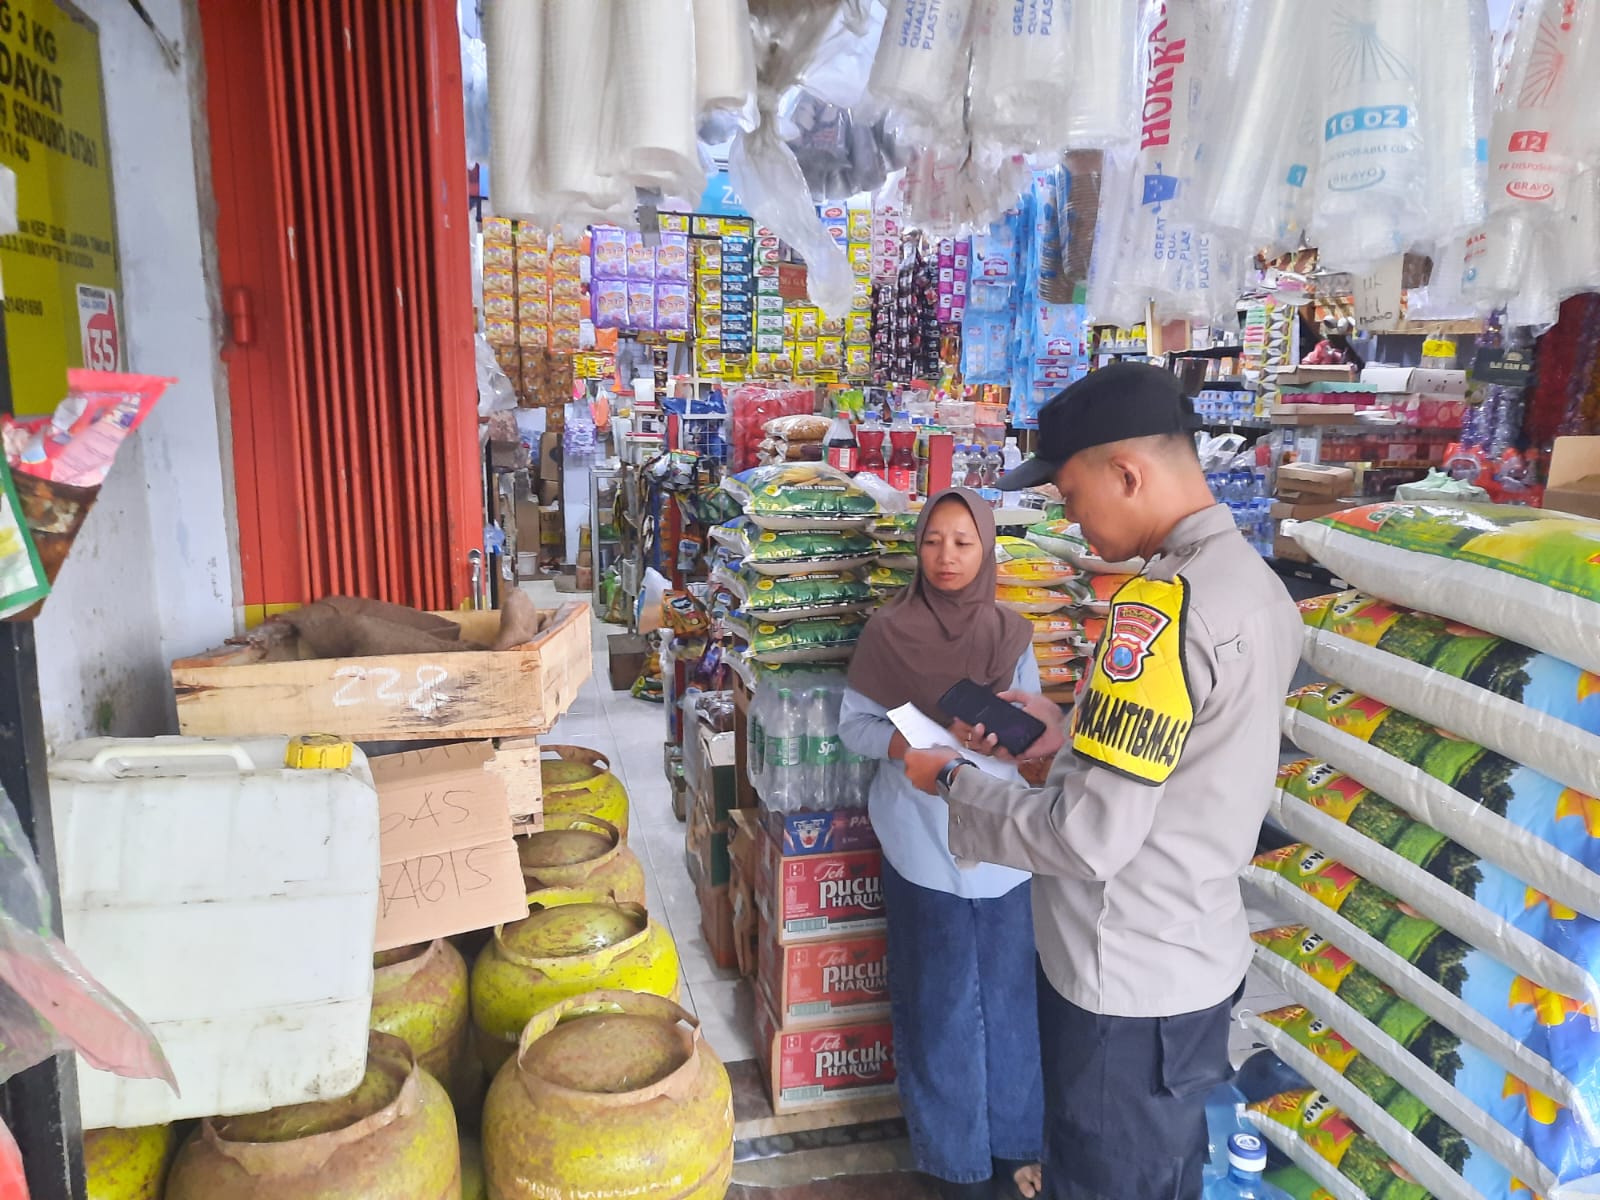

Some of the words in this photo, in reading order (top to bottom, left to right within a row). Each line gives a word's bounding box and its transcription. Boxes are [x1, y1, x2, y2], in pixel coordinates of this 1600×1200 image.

[18, 11, 27, 44] 3
[32, 20, 56, 63] KG
[1327, 115, 1355, 136] 16
[1363, 109, 1401, 128] OZ
[1517, 135, 1542, 150] 12
[1512, 181, 1551, 193] BRAVO
[1154, 216, 1166, 260] GREAT
[1199, 238, 1210, 289] PLASTIC
[828, 1062, 881, 1078] HARUM
